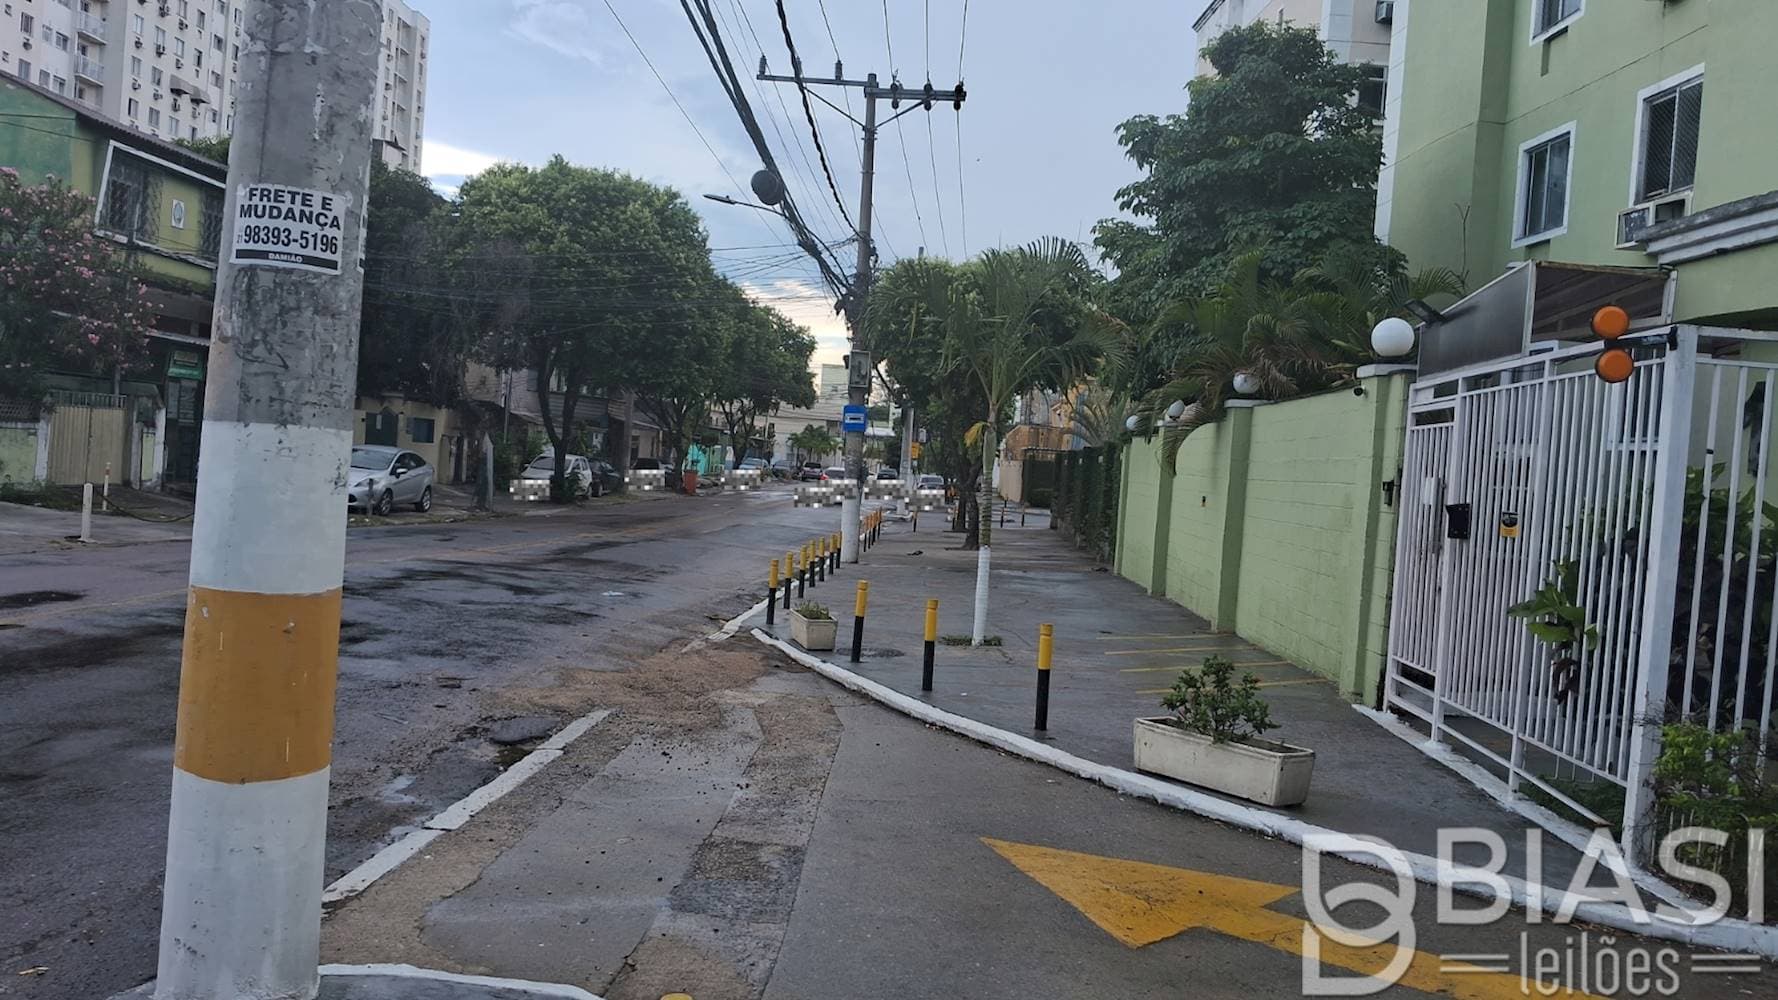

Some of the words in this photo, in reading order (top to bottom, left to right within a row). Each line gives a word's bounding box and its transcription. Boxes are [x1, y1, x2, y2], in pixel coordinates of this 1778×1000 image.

[249, 188, 313, 208] FRETE
[321, 197, 333, 212] E
[239, 204, 341, 231] MUDANÇA
[244, 225, 338, 255] 98393-5196
